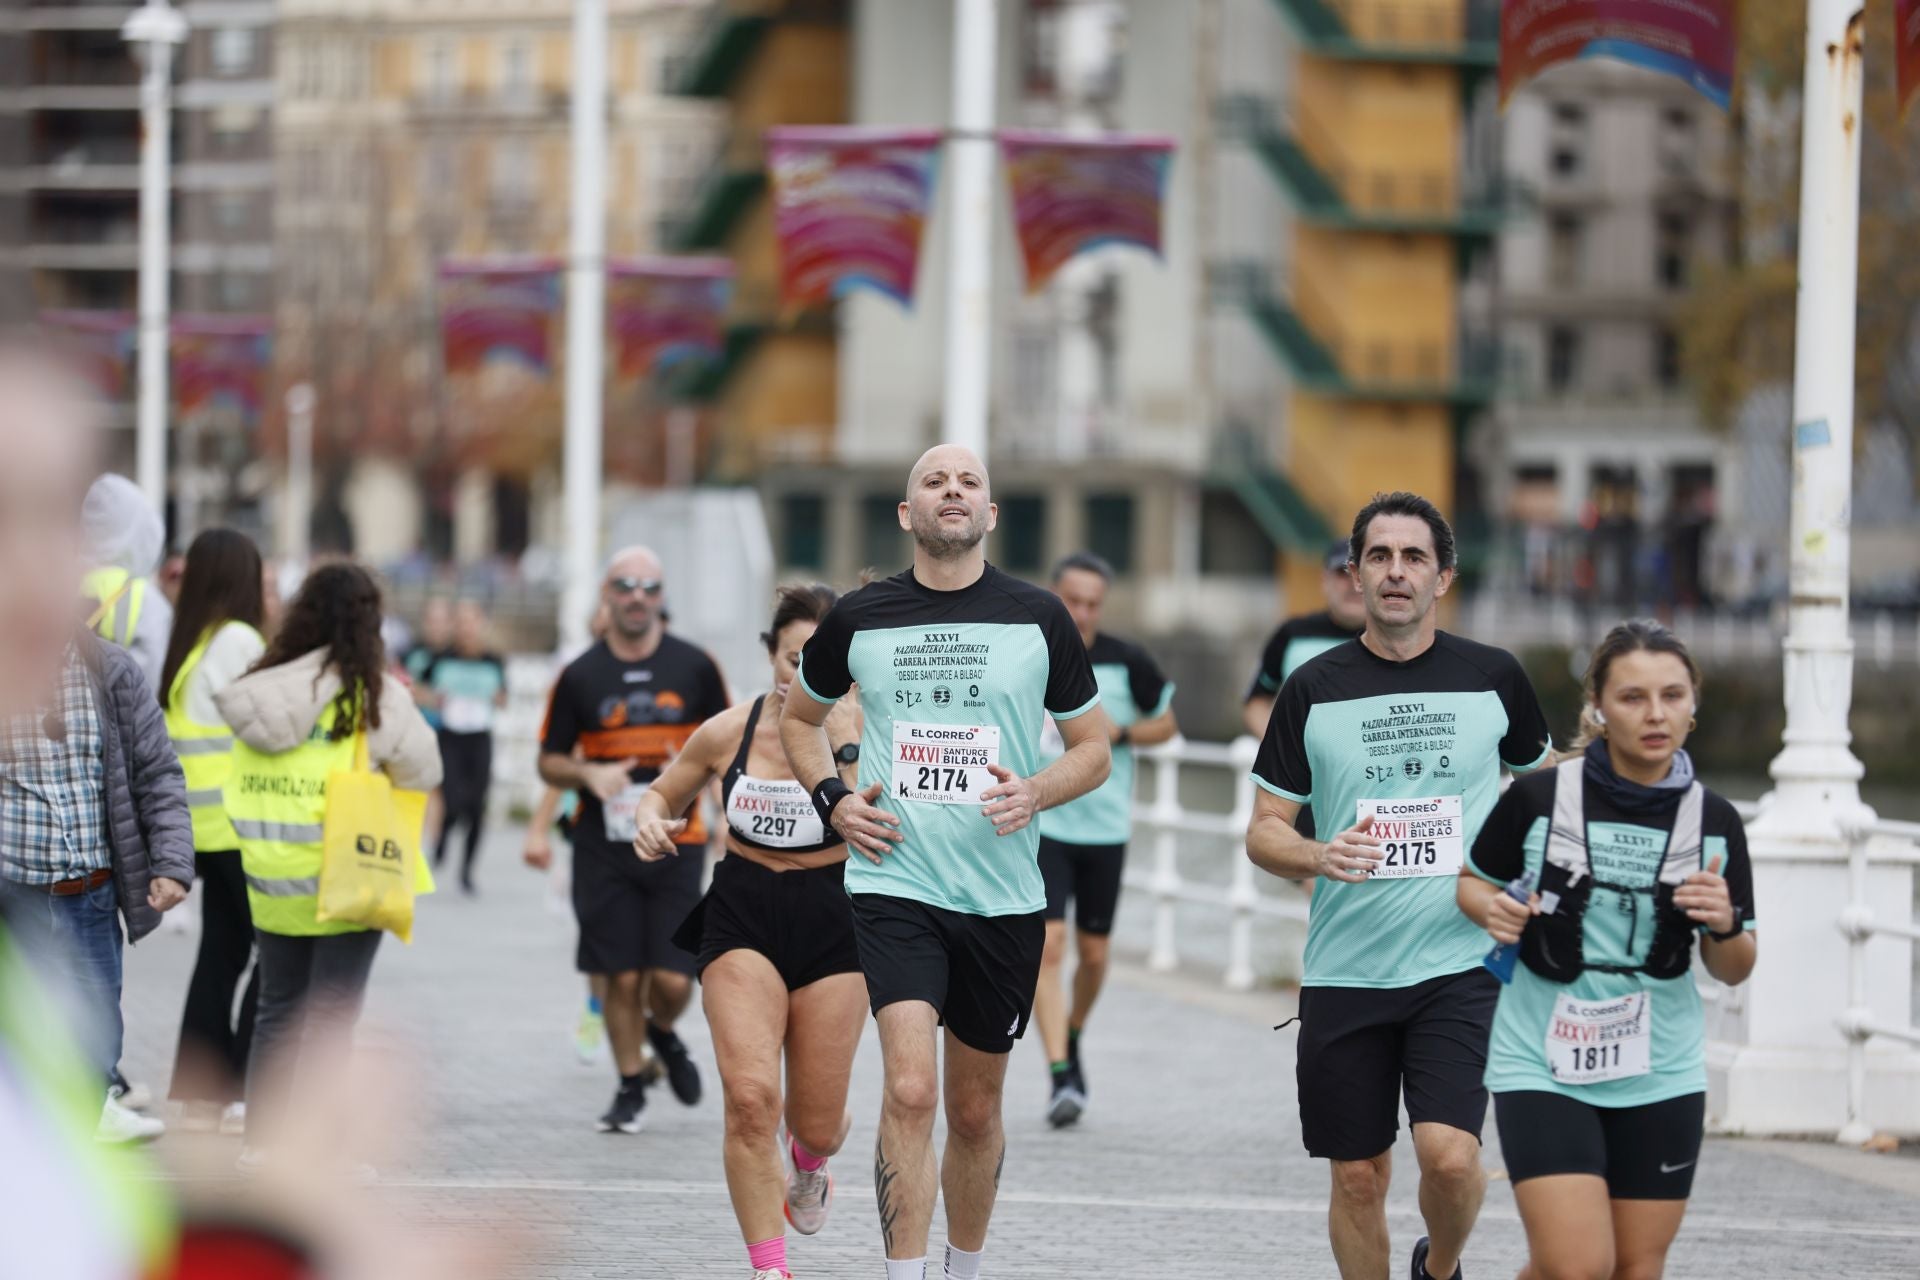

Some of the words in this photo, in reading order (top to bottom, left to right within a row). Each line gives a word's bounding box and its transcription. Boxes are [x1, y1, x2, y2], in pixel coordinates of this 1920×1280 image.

[924, 633, 960, 642] XXXVI
[894, 644, 943, 655] NAZIOARTEKO
[944, 644, 990, 654] LASTERKETA
[894, 657, 927, 667] CARRERA
[928, 656, 988, 666] INTERNACIONAL
[920, 670, 952, 680] SANTURCE
[954, 670, 958, 680] A
[1389, 703, 1425, 715] XXXVI
[1361, 716, 1410, 730] NAZIOARTEKO
[1412, 713, 1456, 724] LASTERKETA
[912, 728, 924, 738] EL
[926, 730, 974, 740] CORREO
[1362, 731, 1396, 742] CARRERA
[1398, 726, 1456, 739] INTERNACIONAL
[944, 748, 988, 756] SANTURCE
[1391, 742, 1422, 754] SANTURCE
[1424, 741, 1428, 751] A
[900, 744, 940, 764] XXXVI
[944, 756, 988, 766] BILBAO
[918, 766, 968, 792] 2174
[1433, 770, 1456, 778] Bilbao
[746, 782, 756, 792] EL
[758, 785, 801, 794] CORREO
[910, 790, 954, 801] kutxabank
[735, 795, 772, 812] XXXVI
[1376, 805, 1390, 814] EL
[1392, 804, 1438, 814] CORREO
[774, 808, 814, 816] BILBAO
[752, 815, 796, 838] 2297
[1410, 819, 1452, 828] SANTURCE
[1410, 826, 1452, 838] BILBAO
[1614, 834, 1654, 848] XXXVI
[1386, 841, 1436, 866] 2175
[1378, 867, 1424, 876] kutxabank
[1554, 1020, 1597, 1041] XXXVI
[1572, 1044, 1619, 1070] 1811
